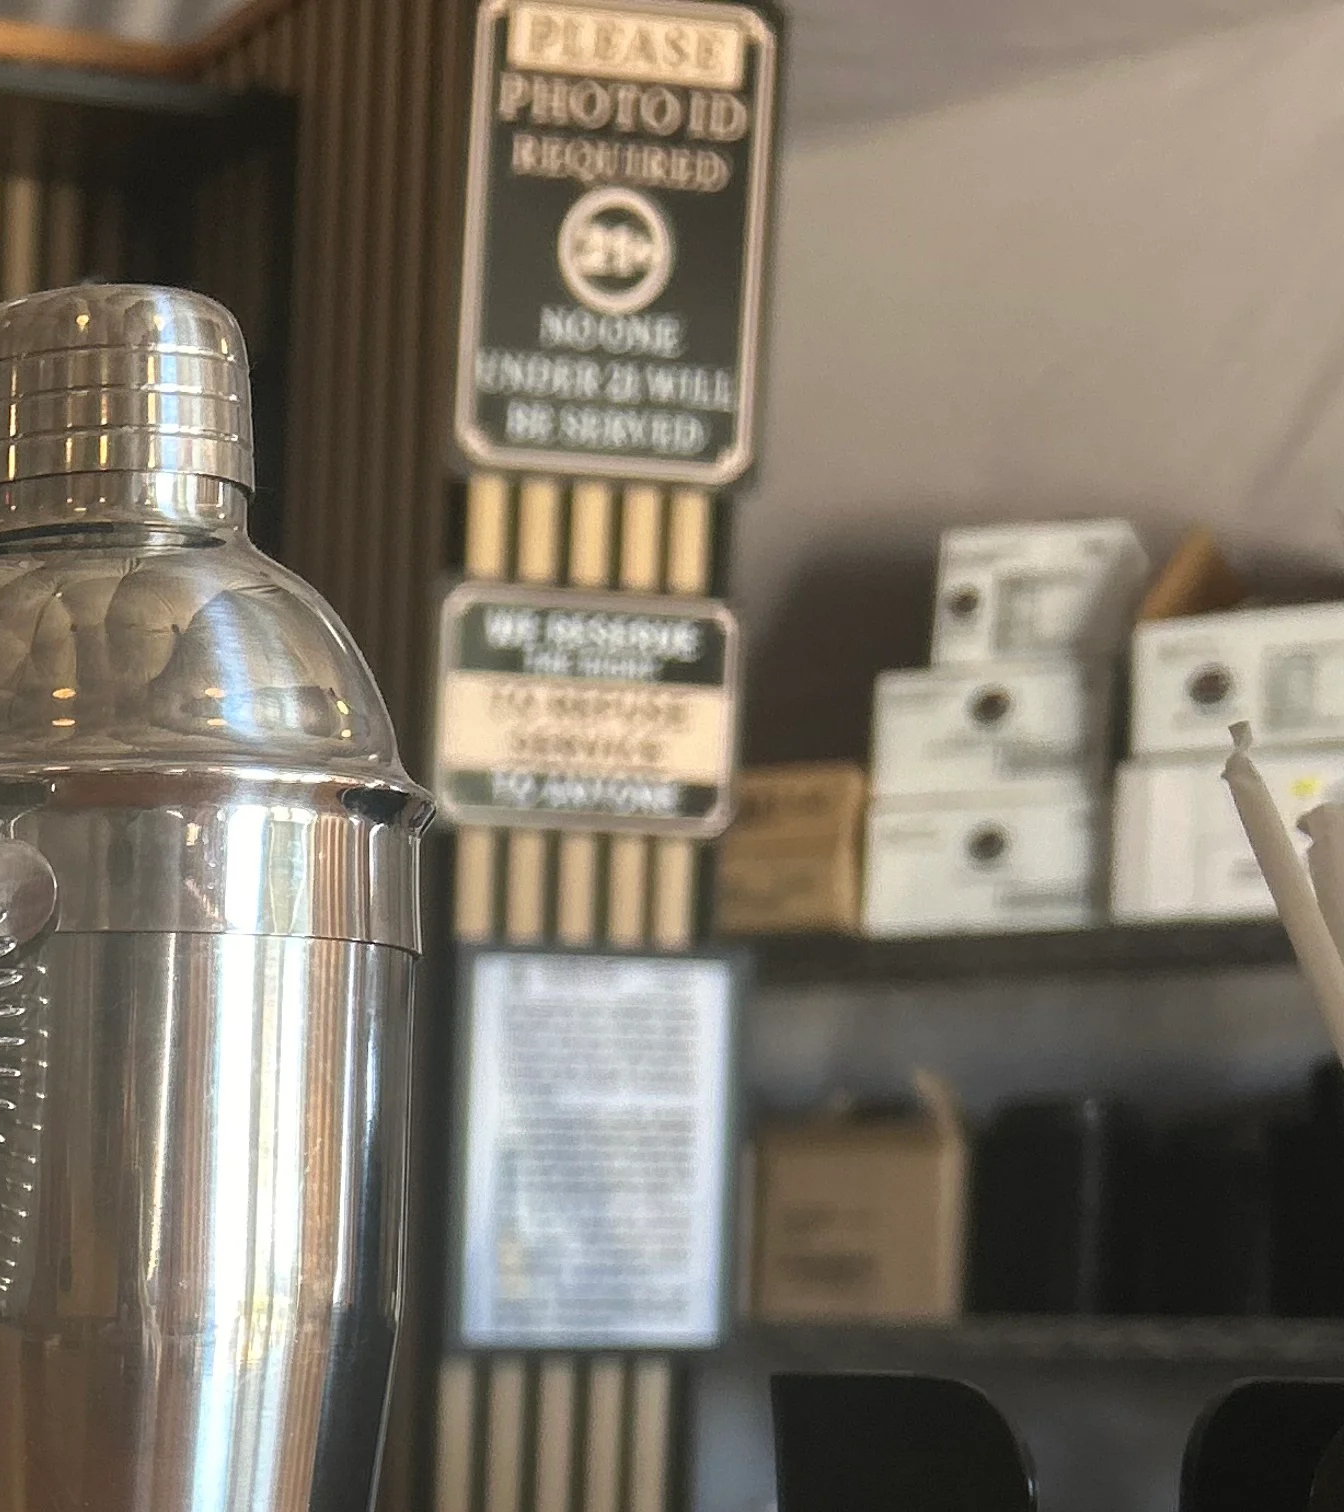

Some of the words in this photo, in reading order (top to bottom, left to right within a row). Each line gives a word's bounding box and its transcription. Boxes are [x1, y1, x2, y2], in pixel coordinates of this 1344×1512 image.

[527, 13, 723, 71] PLEASE
[499, 72, 682, 136] PHOTO
[687, 90, 748, 142] ID
[512, 133, 732, 193] REQUIRED
[474, 350, 602, 399] UNDER
[645, 362, 737, 413] WILL
